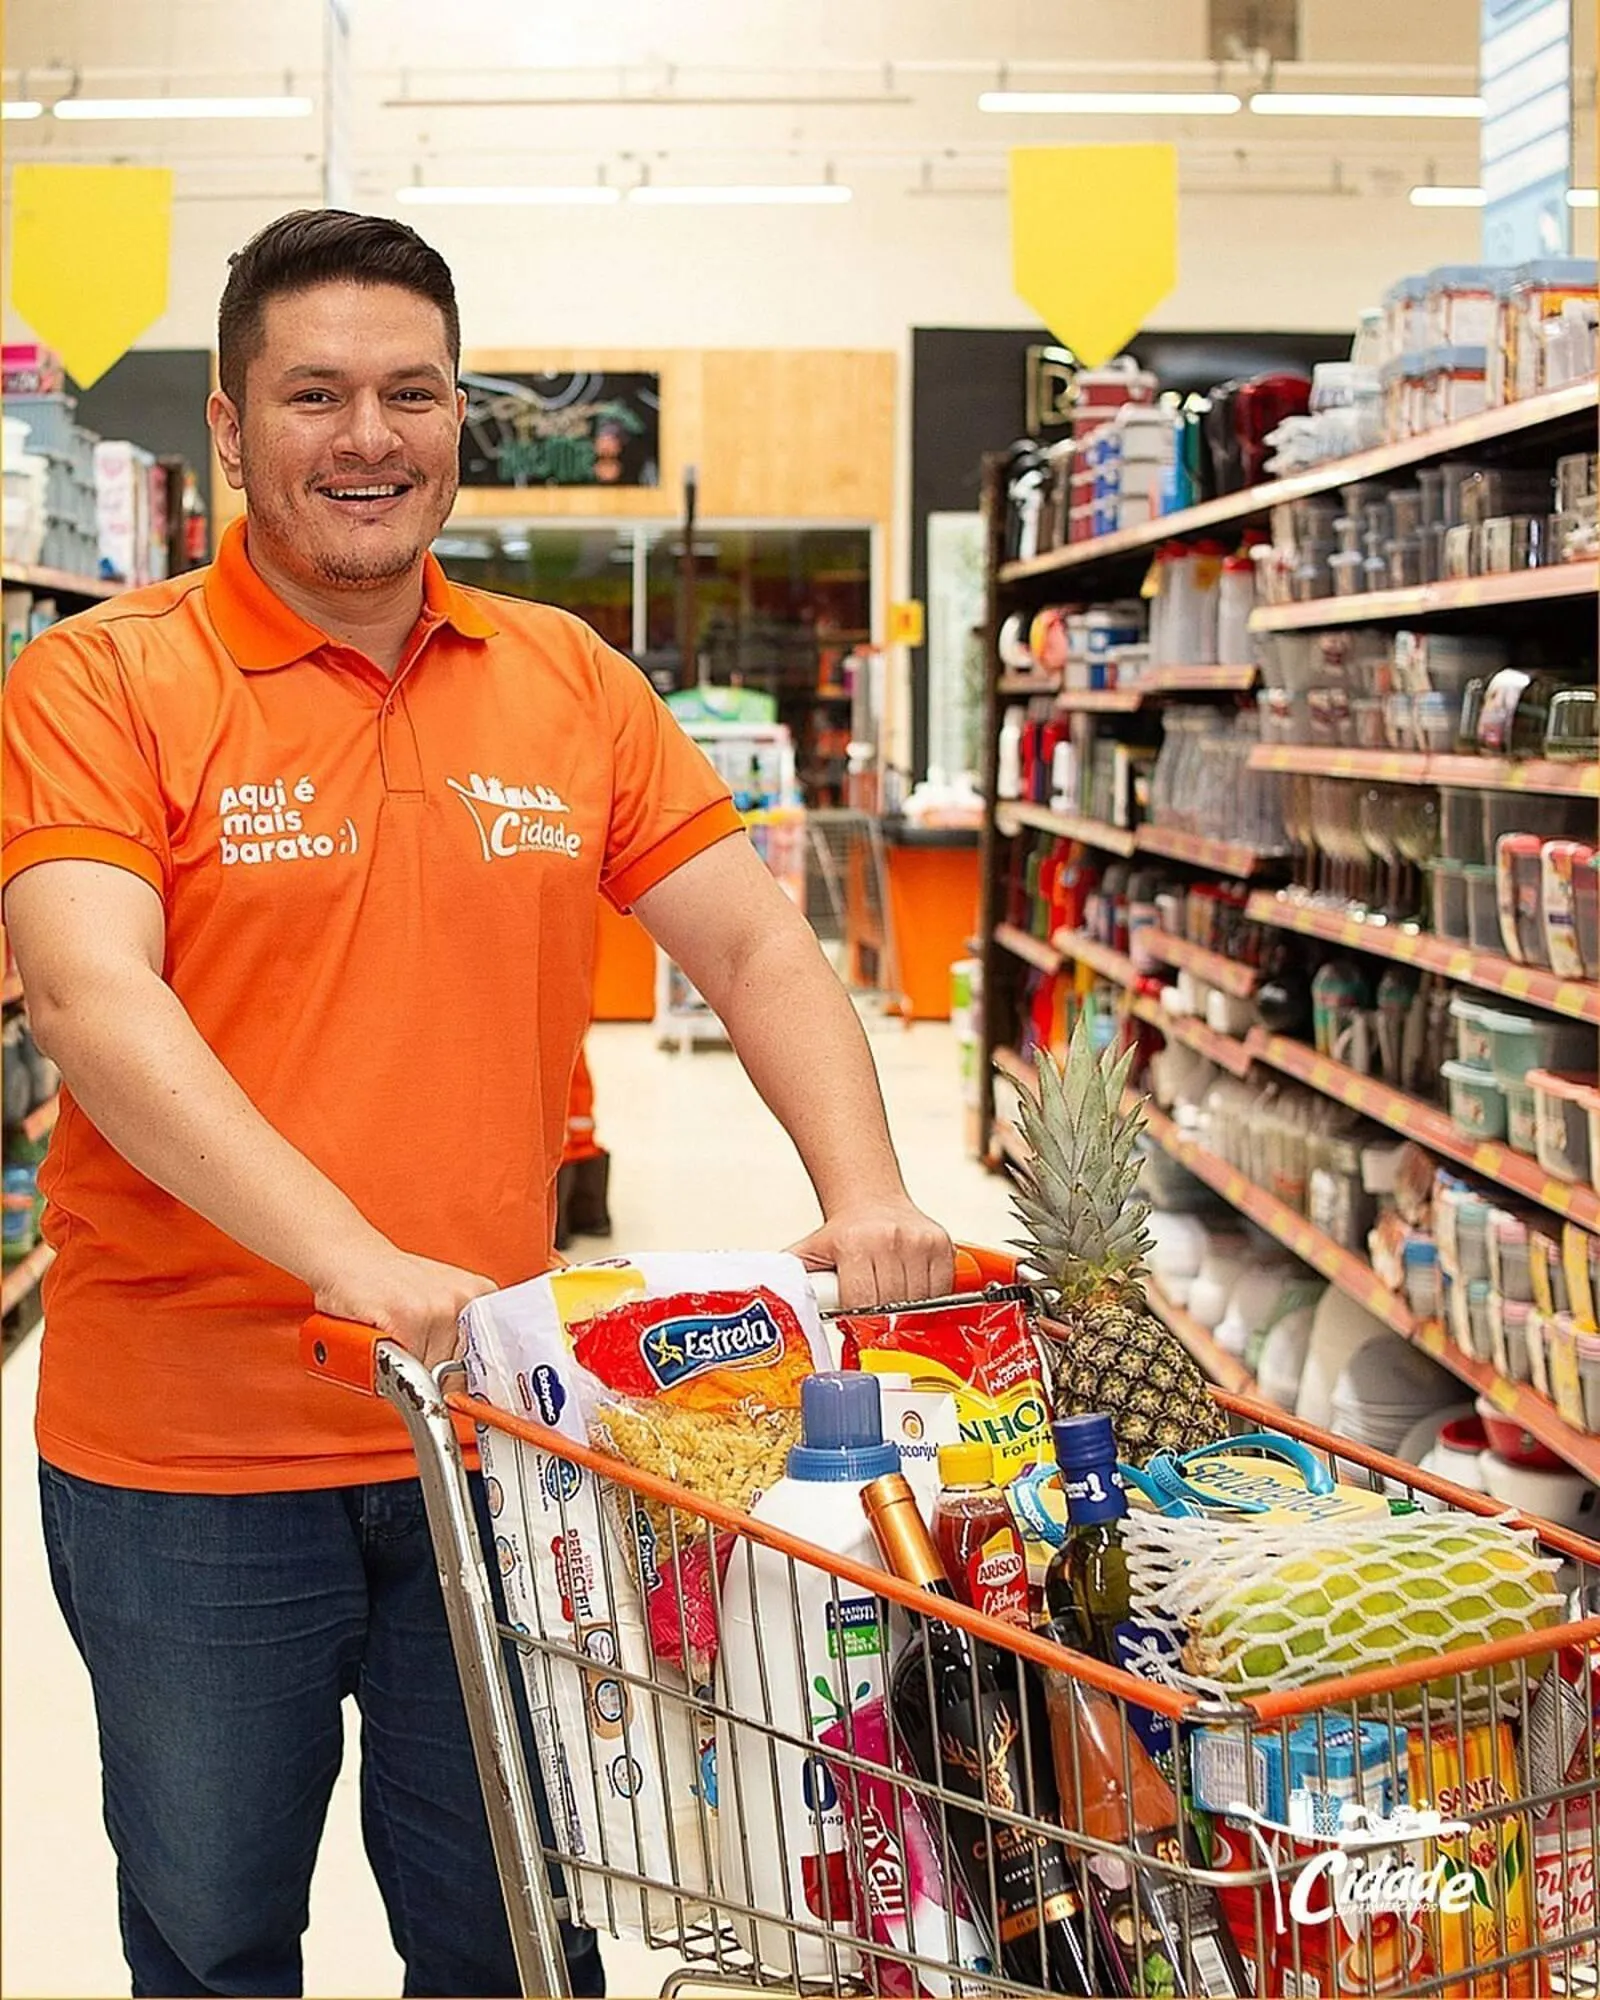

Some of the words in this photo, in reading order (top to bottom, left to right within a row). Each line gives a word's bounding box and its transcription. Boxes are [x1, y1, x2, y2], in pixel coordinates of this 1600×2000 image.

[219, 778, 286, 813] Aqui
[294, 776, 315, 803] é
[223, 808, 303, 836] mais
[490, 811, 582, 858] Cidade
[219, 834, 334, 866] barato
[684, 1317, 774, 1361] Estrela
[537, 1368, 556, 1421] Babysec
[959, 1400, 1045, 1445] NHO
